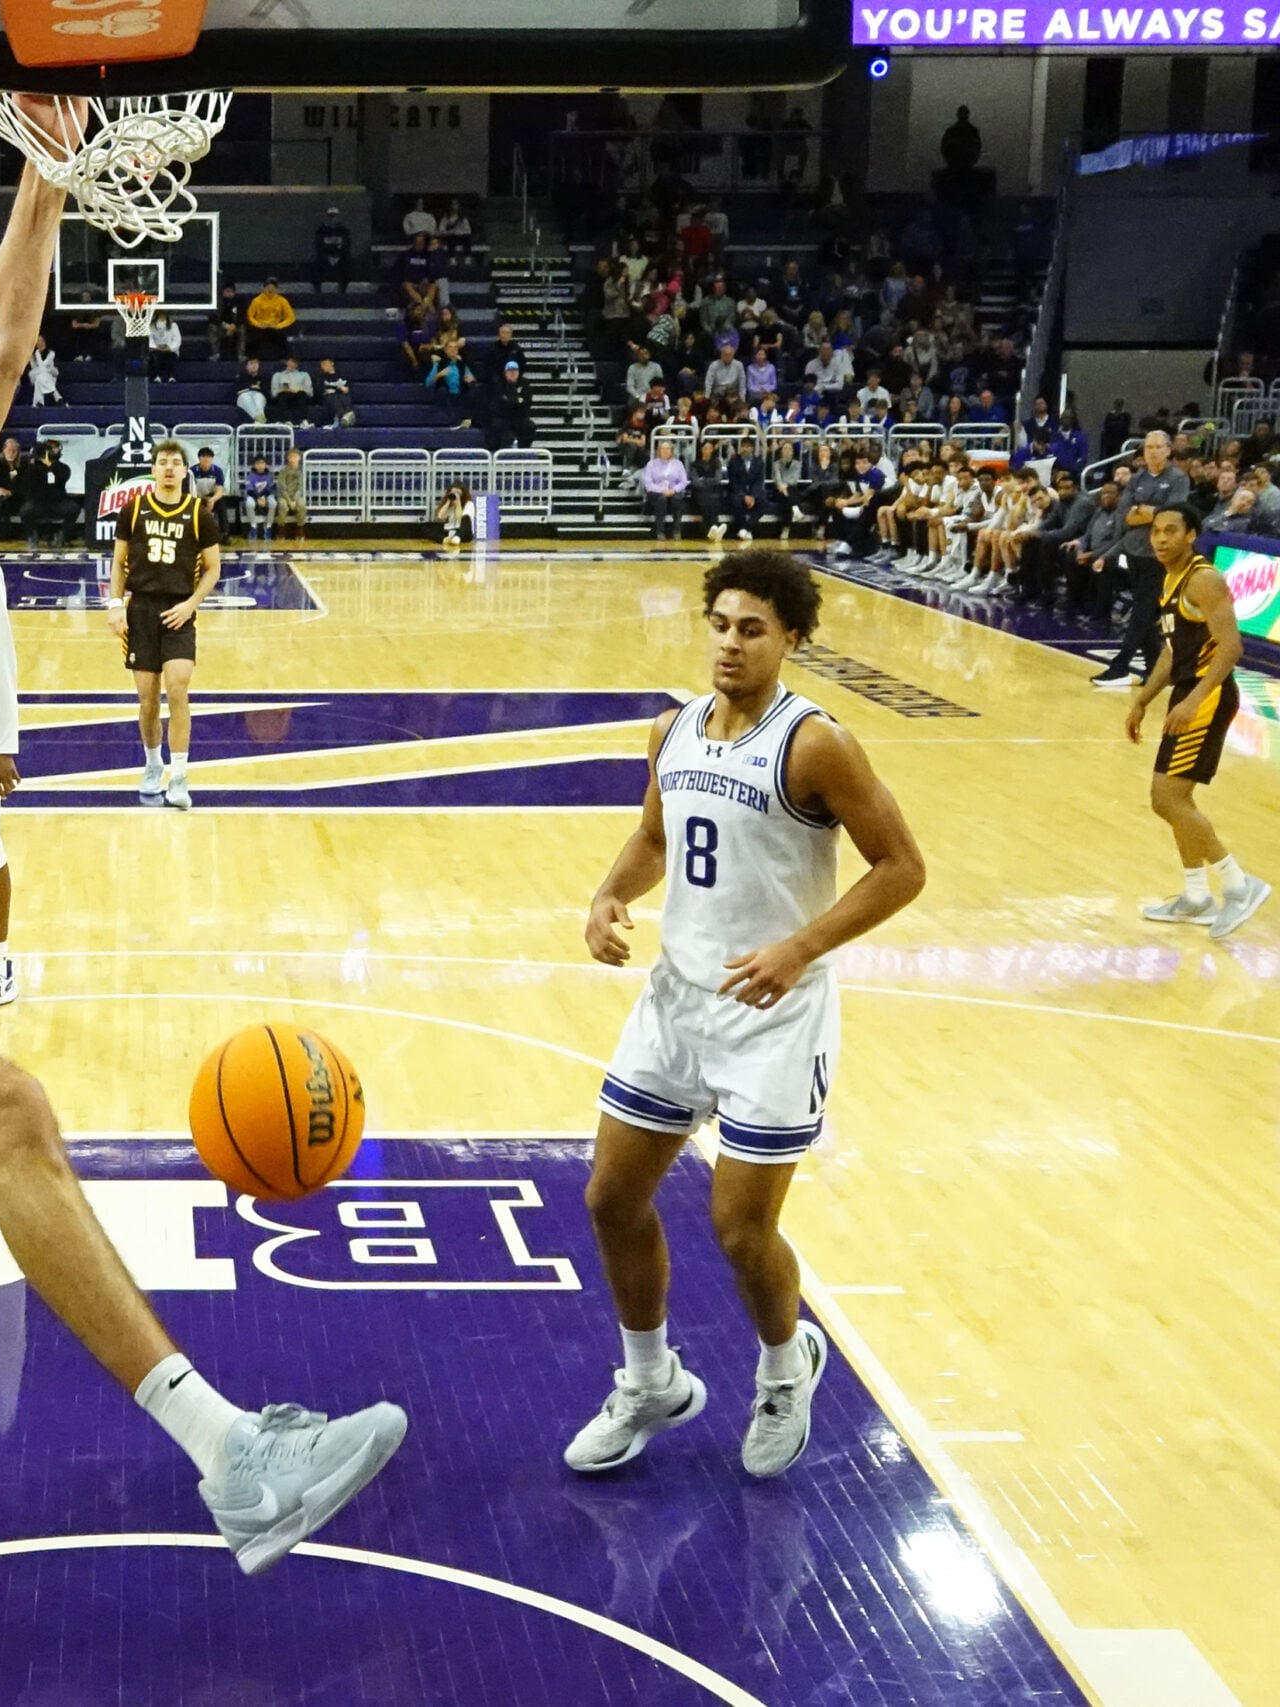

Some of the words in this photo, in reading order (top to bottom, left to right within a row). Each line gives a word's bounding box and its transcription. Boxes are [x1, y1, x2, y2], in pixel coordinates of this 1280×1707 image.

[1043, 8, 1225, 40] ALWAYS
[128, 416, 146, 442] N
[99, 482, 156, 517] LIBMA
[144, 519, 184, 539] VALPO
[147, 537, 177, 565] 35
[660, 769, 771, 815] NORTHWESTERN
[685, 815, 719, 889] 8
